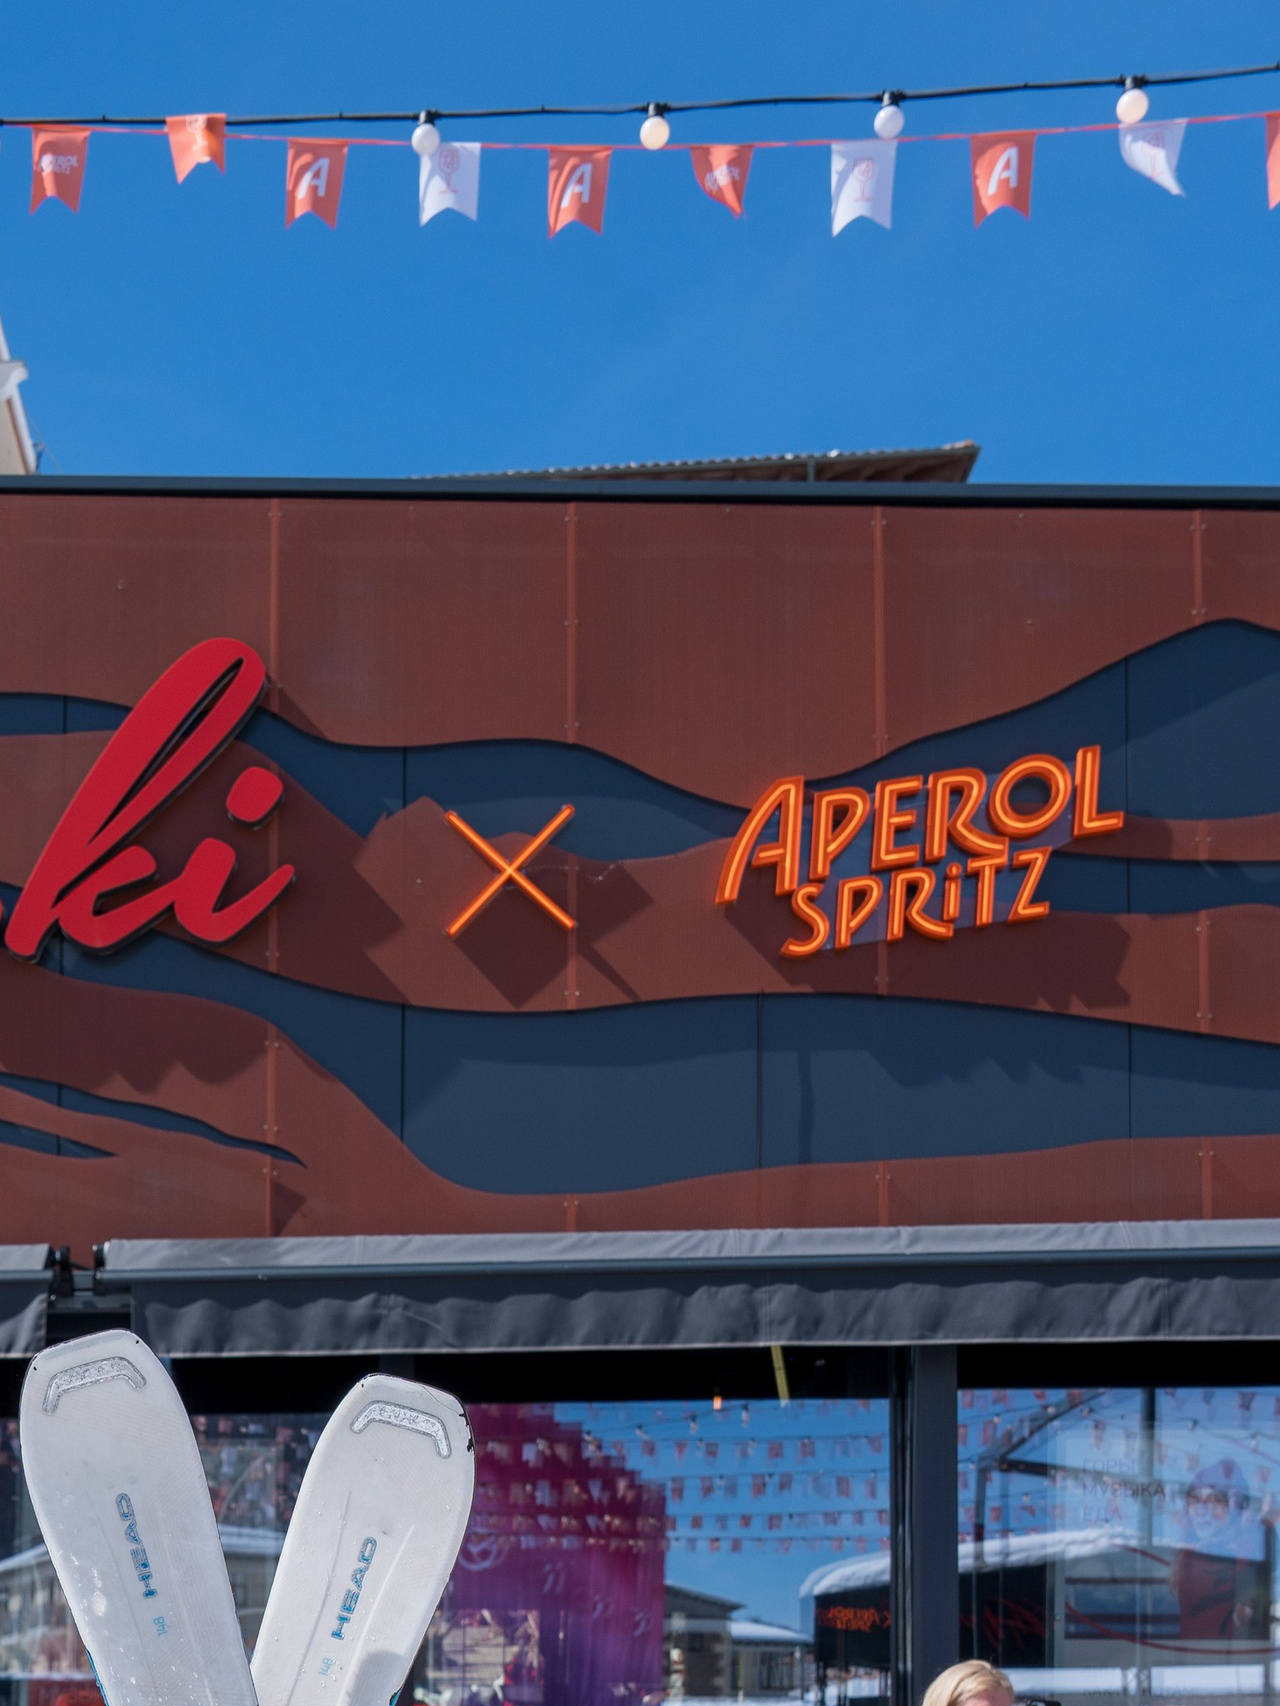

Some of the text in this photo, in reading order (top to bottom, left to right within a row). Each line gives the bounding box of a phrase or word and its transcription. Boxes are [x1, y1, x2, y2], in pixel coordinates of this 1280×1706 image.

[296, 157, 330, 200] A
[560, 163, 593, 209] A
[988, 146, 1019, 197] A
[715, 745, 1124, 904] APEROL
[115, 1491, 159, 1600] HEAD
[330, 1536, 378, 1641] HEAD
[152, 1616, 168, 1638] 148
[318, 1656, 335, 1677] 148
